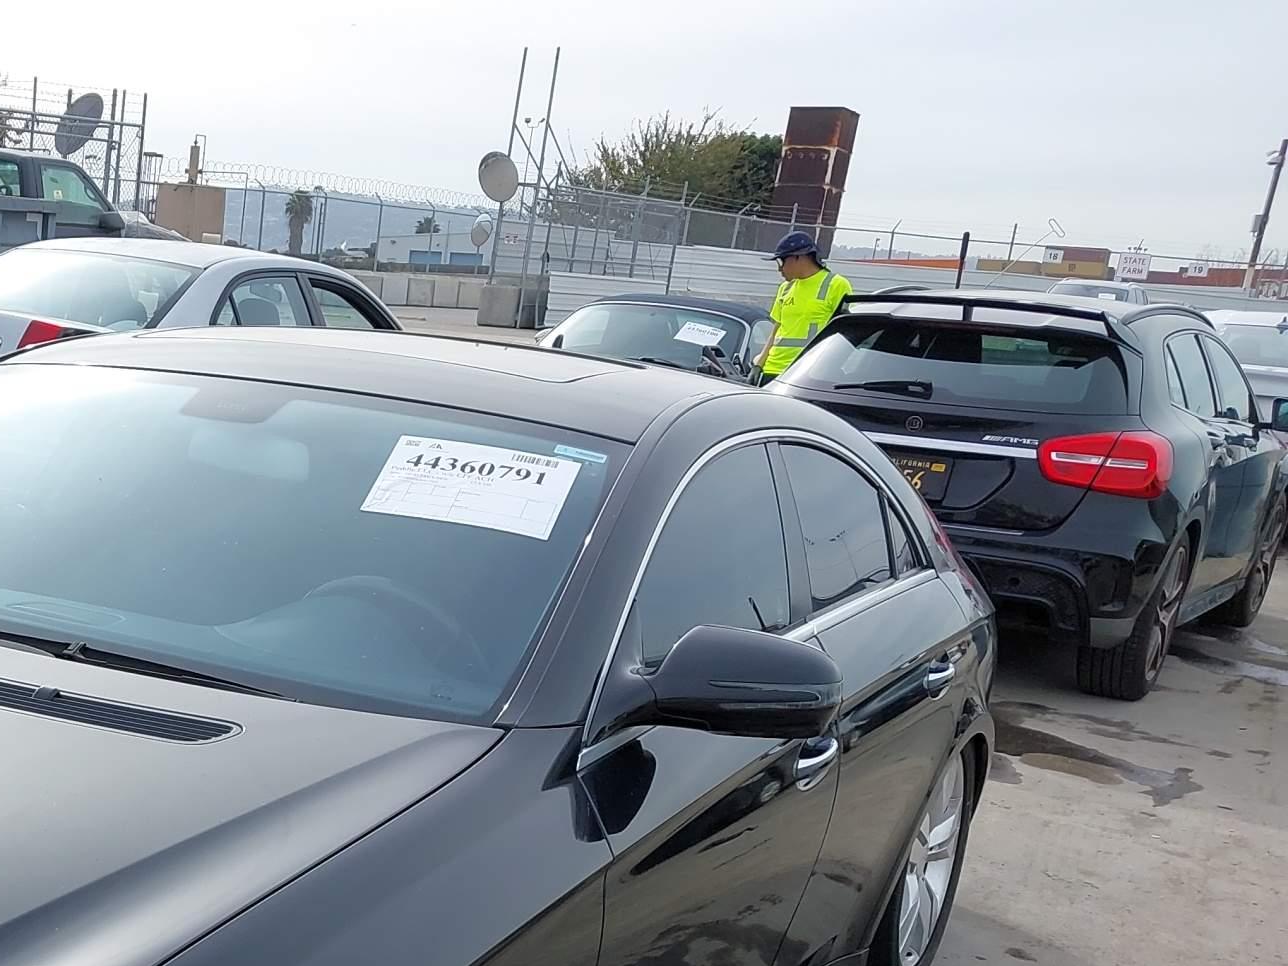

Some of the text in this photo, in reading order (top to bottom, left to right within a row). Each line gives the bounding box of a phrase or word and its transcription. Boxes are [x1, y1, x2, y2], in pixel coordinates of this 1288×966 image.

[1123, 256, 1147, 266] STATE
[1121, 266, 1144, 275] FARM
[1193, 265, 1204, 274] 19
[999, 436, 1040, 446] AMG
[891, 458, 930, 469] ALIFORNIA
[405, 453, 548, 485] 44360791
